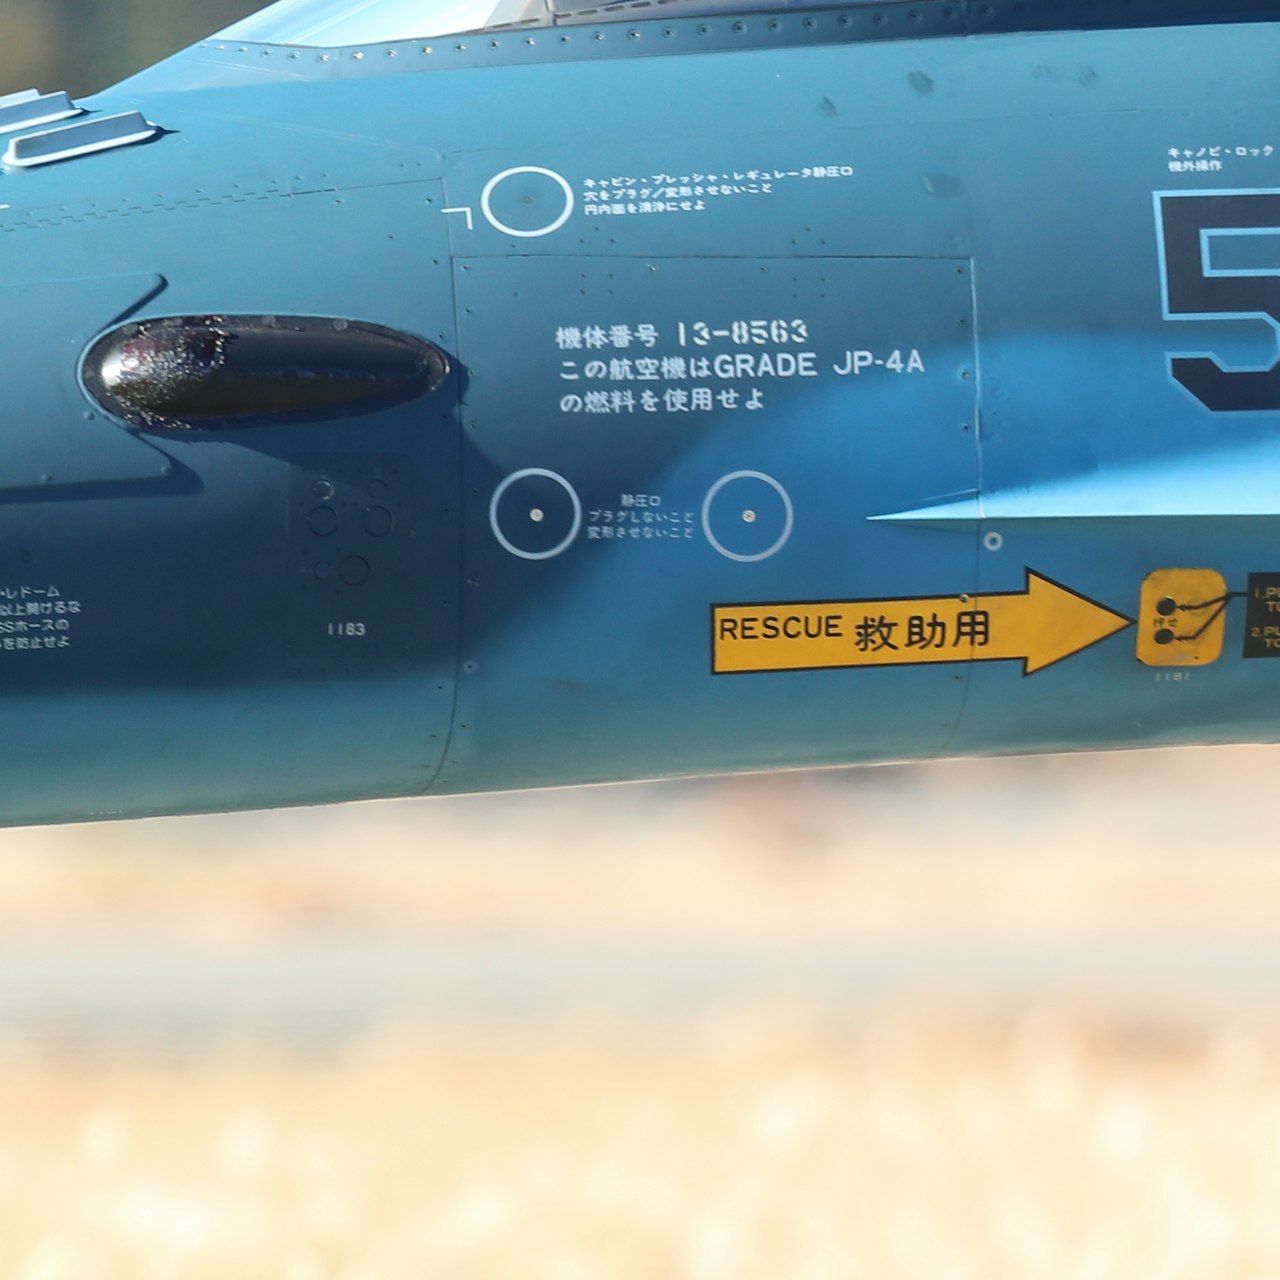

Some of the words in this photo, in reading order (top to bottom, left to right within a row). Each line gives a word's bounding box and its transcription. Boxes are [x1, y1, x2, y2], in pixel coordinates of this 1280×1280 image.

[555, 323, 660, 349] 機体番号
[677, 318, 810, 347] 13-8563
[559, 352, 818, 380] この航空機はGRADE
[833, 348, 925, 376] JP-4A
[559, 387, 765, 414] の燃料を使用せよ
[620, 493, 661, 508] 静圧口
[587, 525, 695, 540] 変形させないこと
[328, 622, 366, 636] 1183
[718, 615, 844, 641] RESCUE
[855, 610, 990, 653] 救助用
